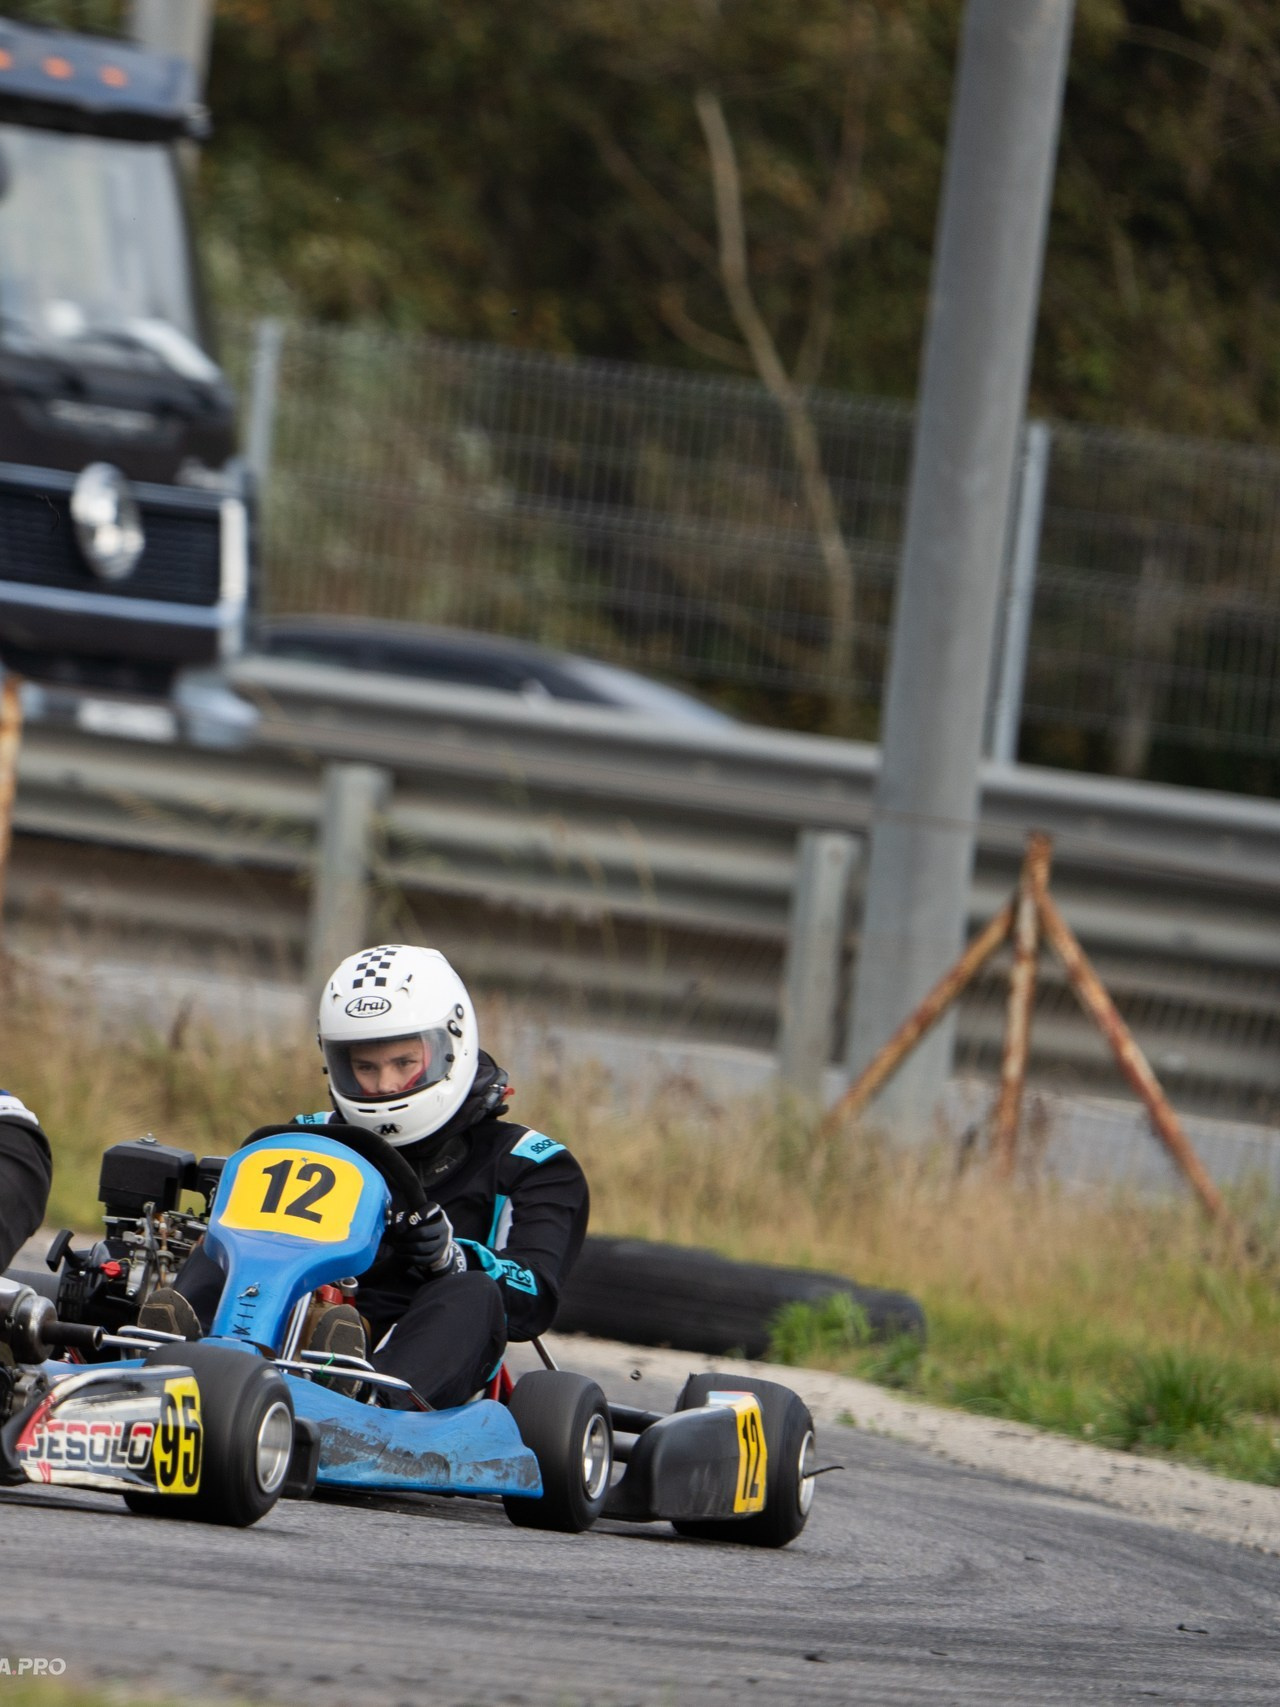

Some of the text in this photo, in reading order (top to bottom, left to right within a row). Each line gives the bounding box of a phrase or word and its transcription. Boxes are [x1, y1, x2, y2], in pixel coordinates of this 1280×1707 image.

[347, 998, 386, 1014] Arai
[260, 1159, 336, 1224] 12
[27, 1392, 202, 1488] JESOLO 95
[742, 1412, 761, 1500] 12
